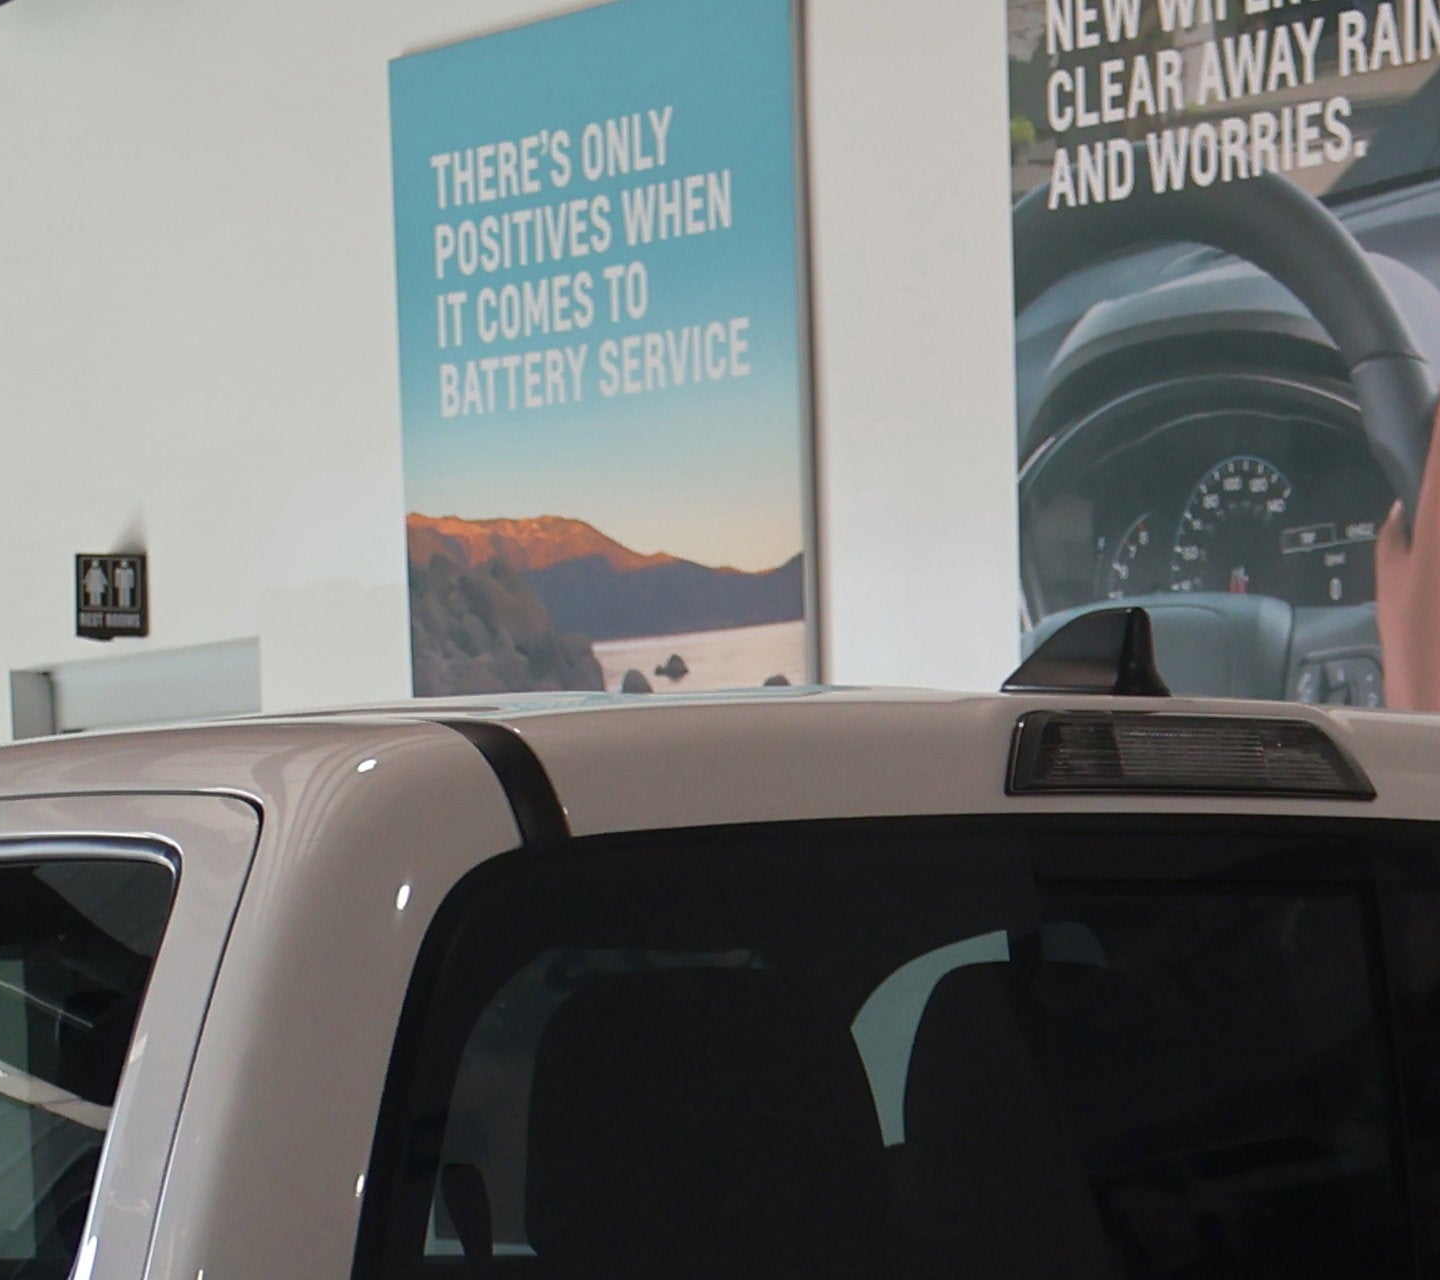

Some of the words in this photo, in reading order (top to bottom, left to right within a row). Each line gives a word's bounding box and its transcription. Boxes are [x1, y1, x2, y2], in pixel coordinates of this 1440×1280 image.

[1047, 49, 1184, 132] CLEAR
[1197, 17, 1325, 105] AWAY
[430, 129, 572, 210] THERE'S
[581, 106, 673, 181] ONLY
[1048, 138, 1134, 210] AND
[1147, 97, 1368, 194] WORRIES.
[434, 195, 612, 279] POSITIVES
[620, 169, 732, 246] WHEN
[437, 292, 468, 348] IT
[476, 271, 594, 343] COMES
[602, 260, 648, 322] TO
[440, 344, 588, 418] BATTERY
[599, 317, 751, 397] SERVICE
